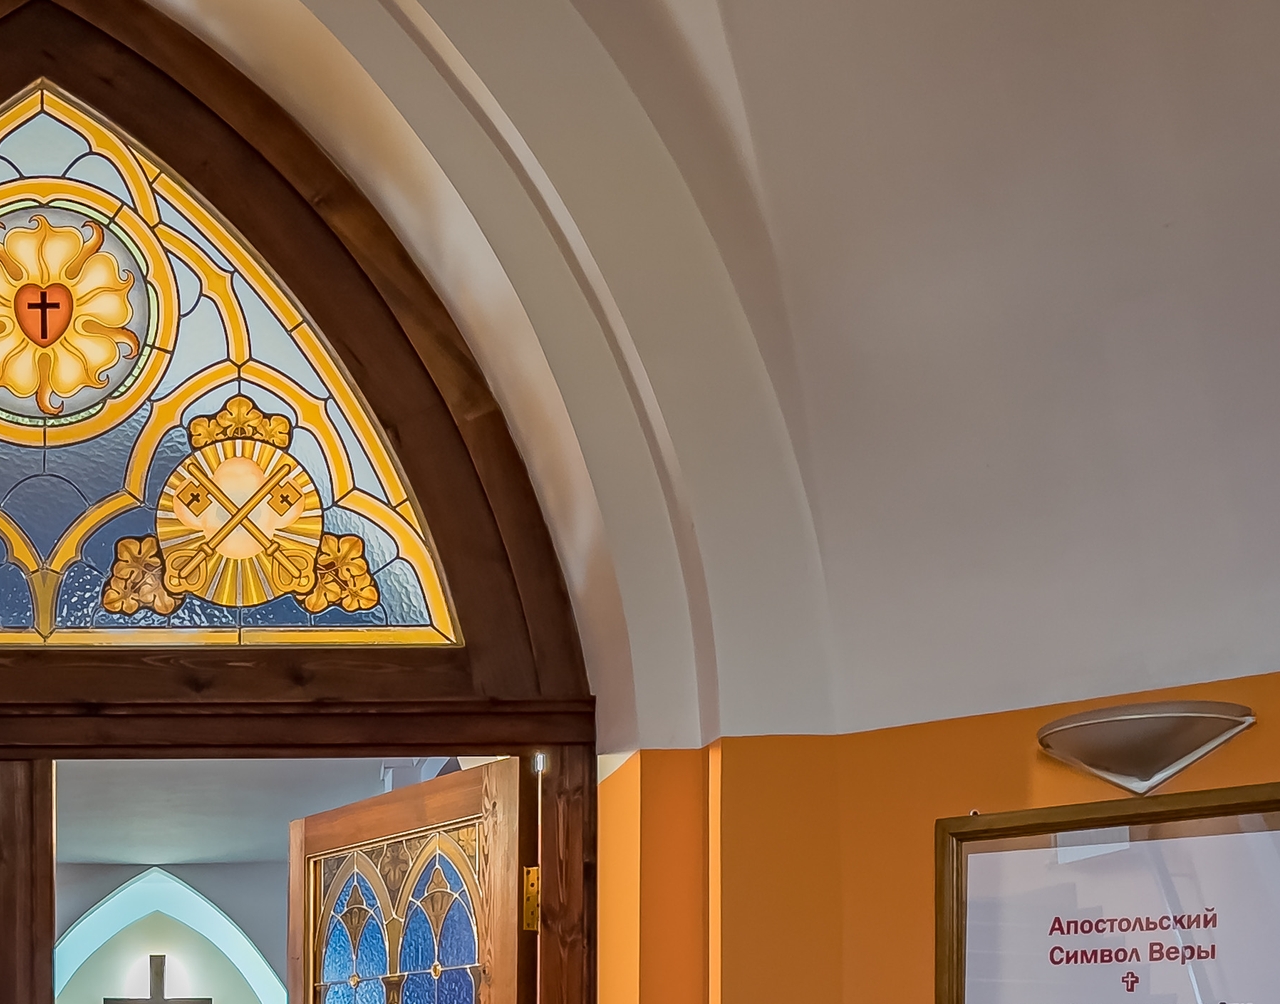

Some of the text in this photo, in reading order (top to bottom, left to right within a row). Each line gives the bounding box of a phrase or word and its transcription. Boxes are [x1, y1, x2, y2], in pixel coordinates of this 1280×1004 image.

[1048, 907, 1218, 936] Апостольский
[1049, 941, 1216, 966] Символ Веры
